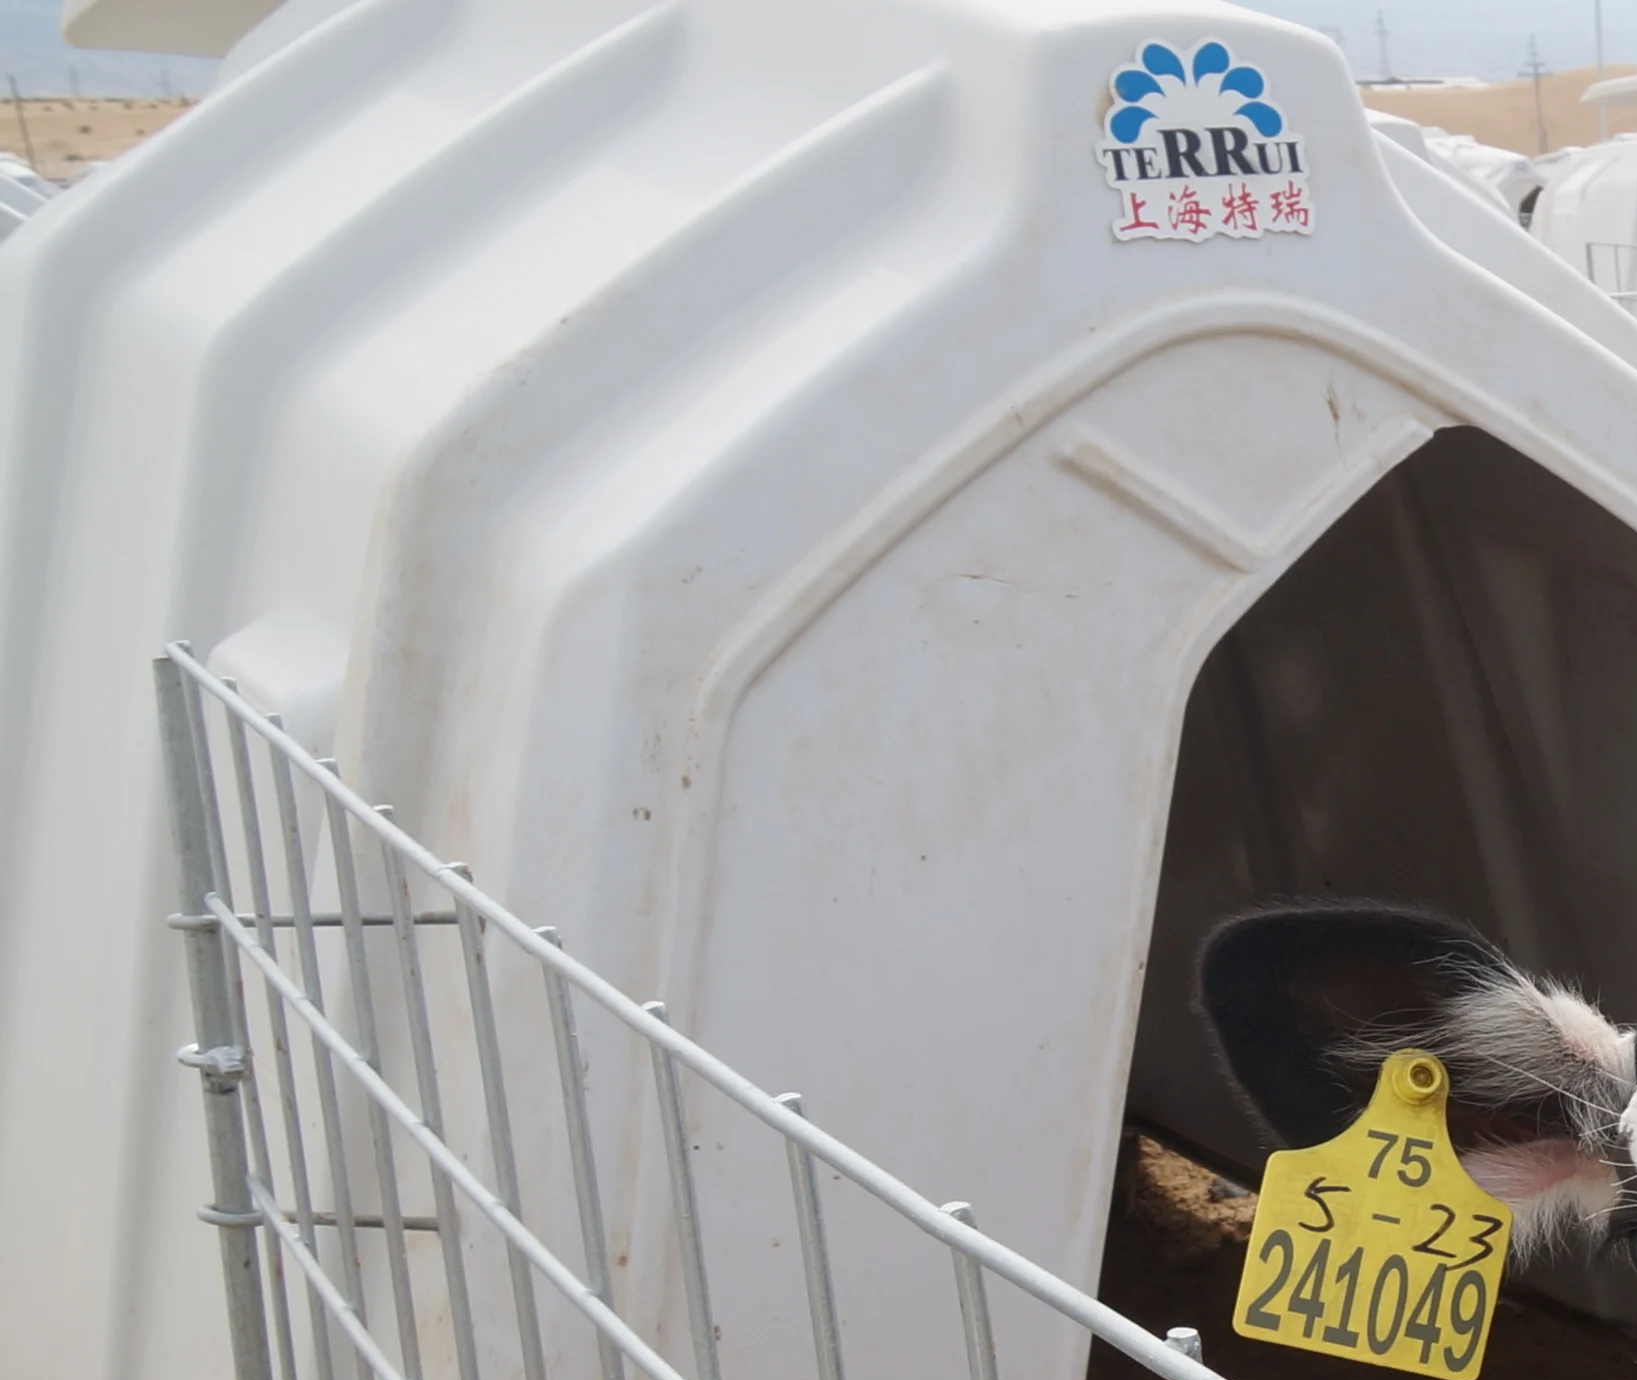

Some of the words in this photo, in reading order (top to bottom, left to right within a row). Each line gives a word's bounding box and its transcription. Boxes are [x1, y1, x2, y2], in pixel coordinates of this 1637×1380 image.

[1102, 126, 1304, 181] TERRUI
[1119, 180, 1310, 234] 上海特瑞
[1367, 1129, 1434, 1188] 75
[1298, 1177, 1352, 1232] 5
[1411, 1204, 1504, 1272] 23
[1244, 1229, 1487, 1372] 241049
